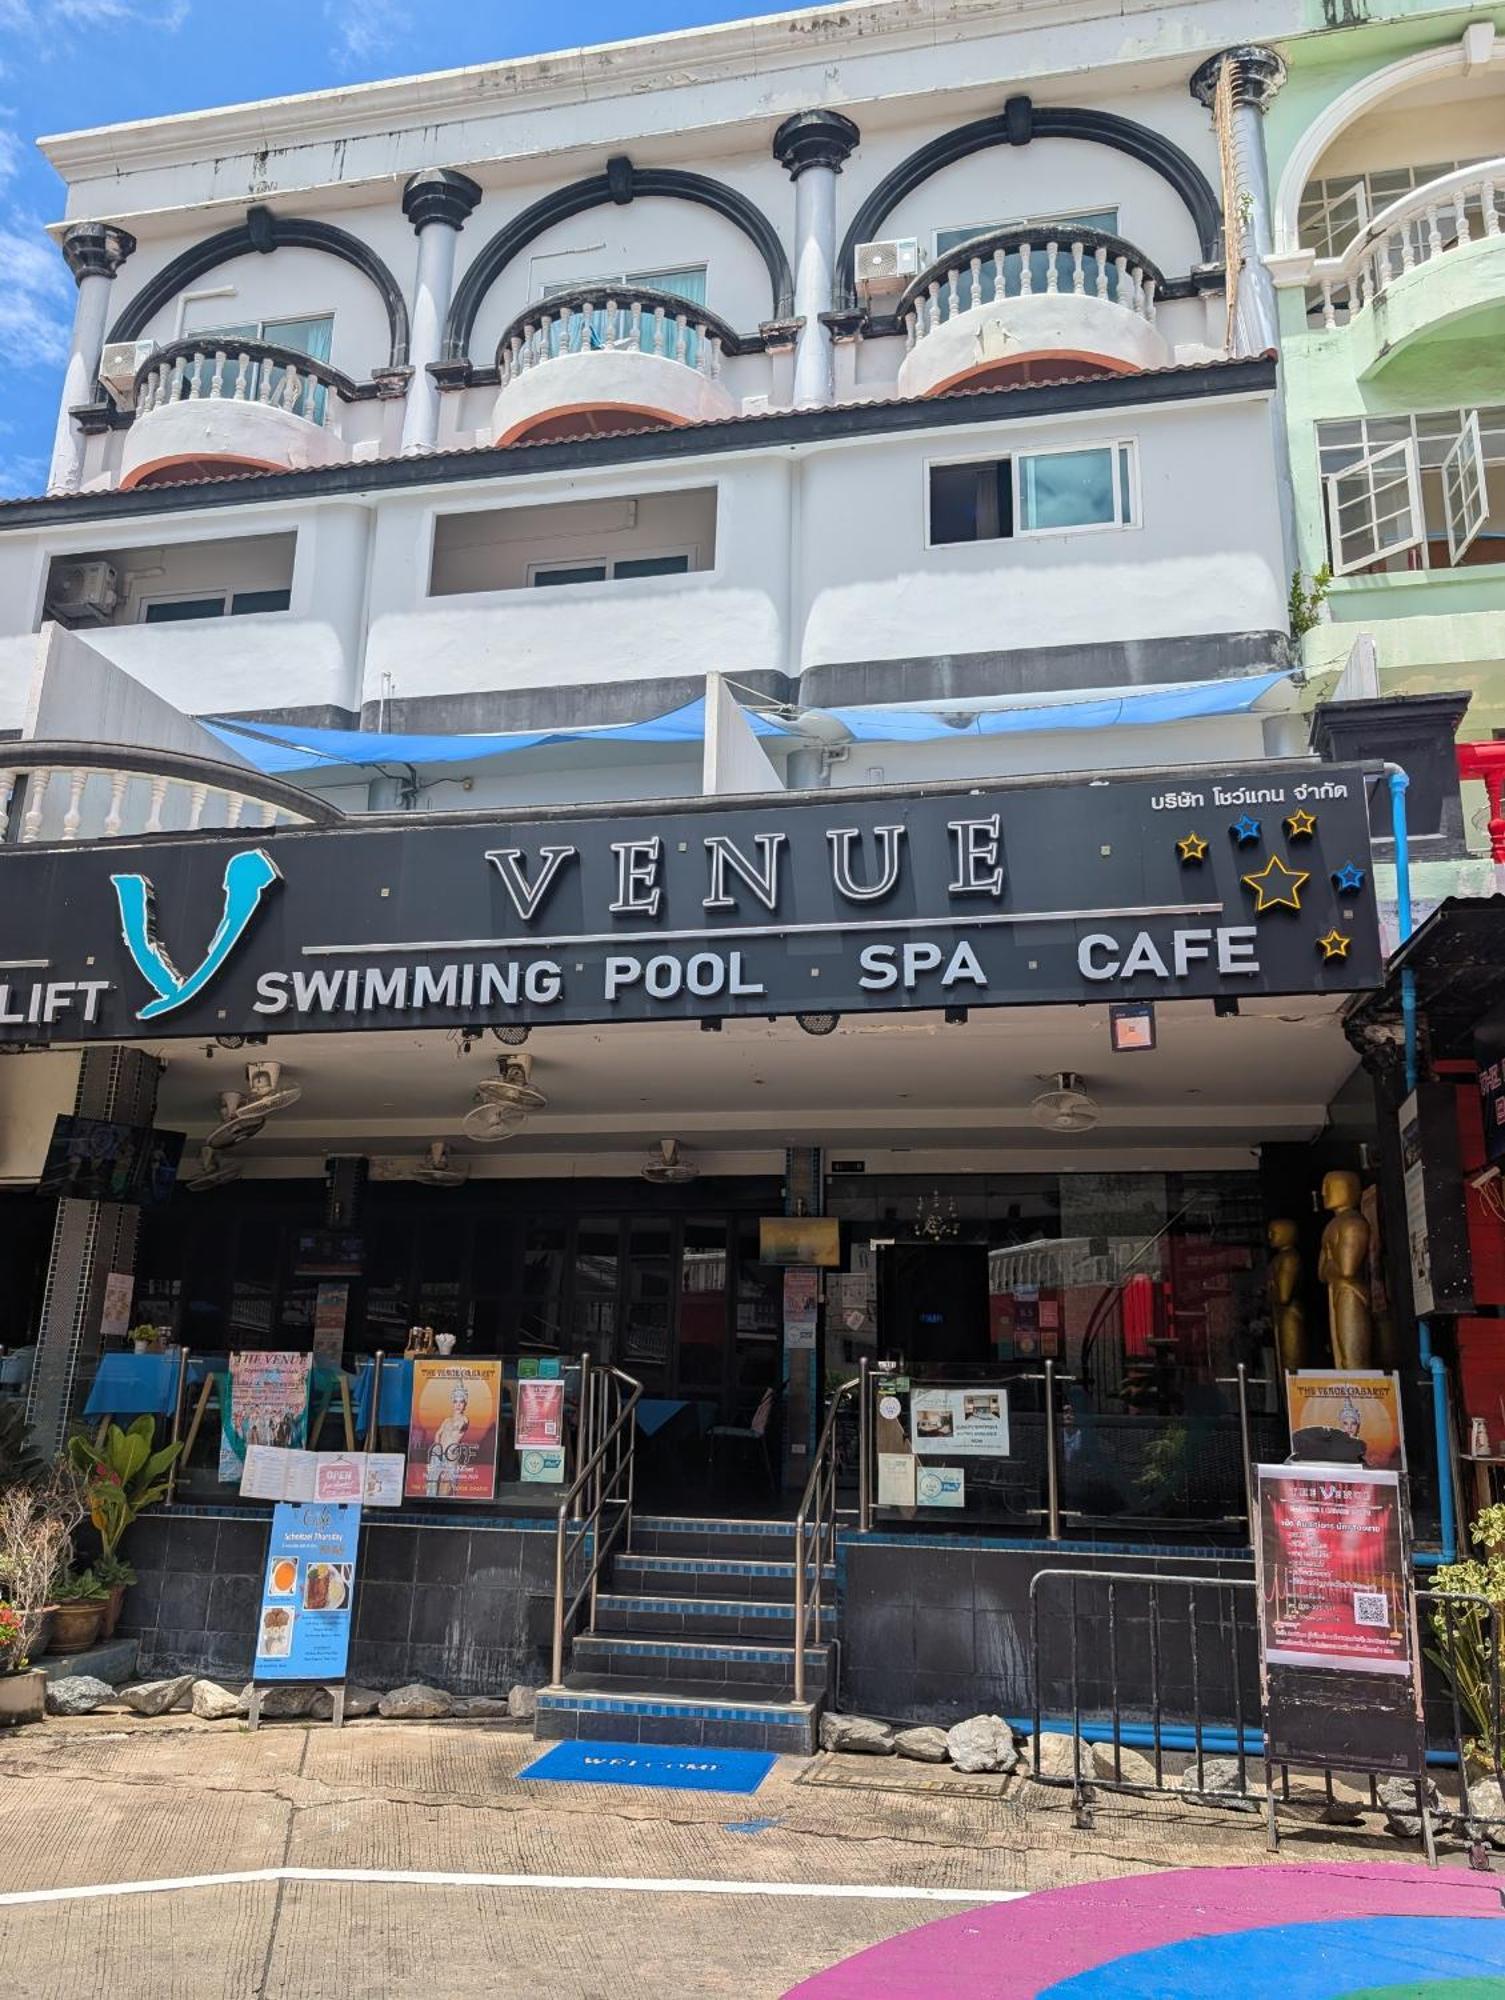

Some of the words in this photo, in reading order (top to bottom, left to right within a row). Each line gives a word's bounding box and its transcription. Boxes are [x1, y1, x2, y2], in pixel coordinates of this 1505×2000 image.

[1151, 790, 1204, 809] บริษัท
[1293, 781, 1348, 800] จำกัด
[485, 812, 1004, 920] VENUE
[254, 959, 561, 1015] SWIMMING
[604, 950, 765, 1000] POOL
[858, 940, 988, 989] SPA
[1077, 926, 1260, 980] CAFE
[0, 981, 110, 1023] LIFT
[1297, 1386, 1316, 1396] THE
[325, 1469, 353, 1481] OPEN
